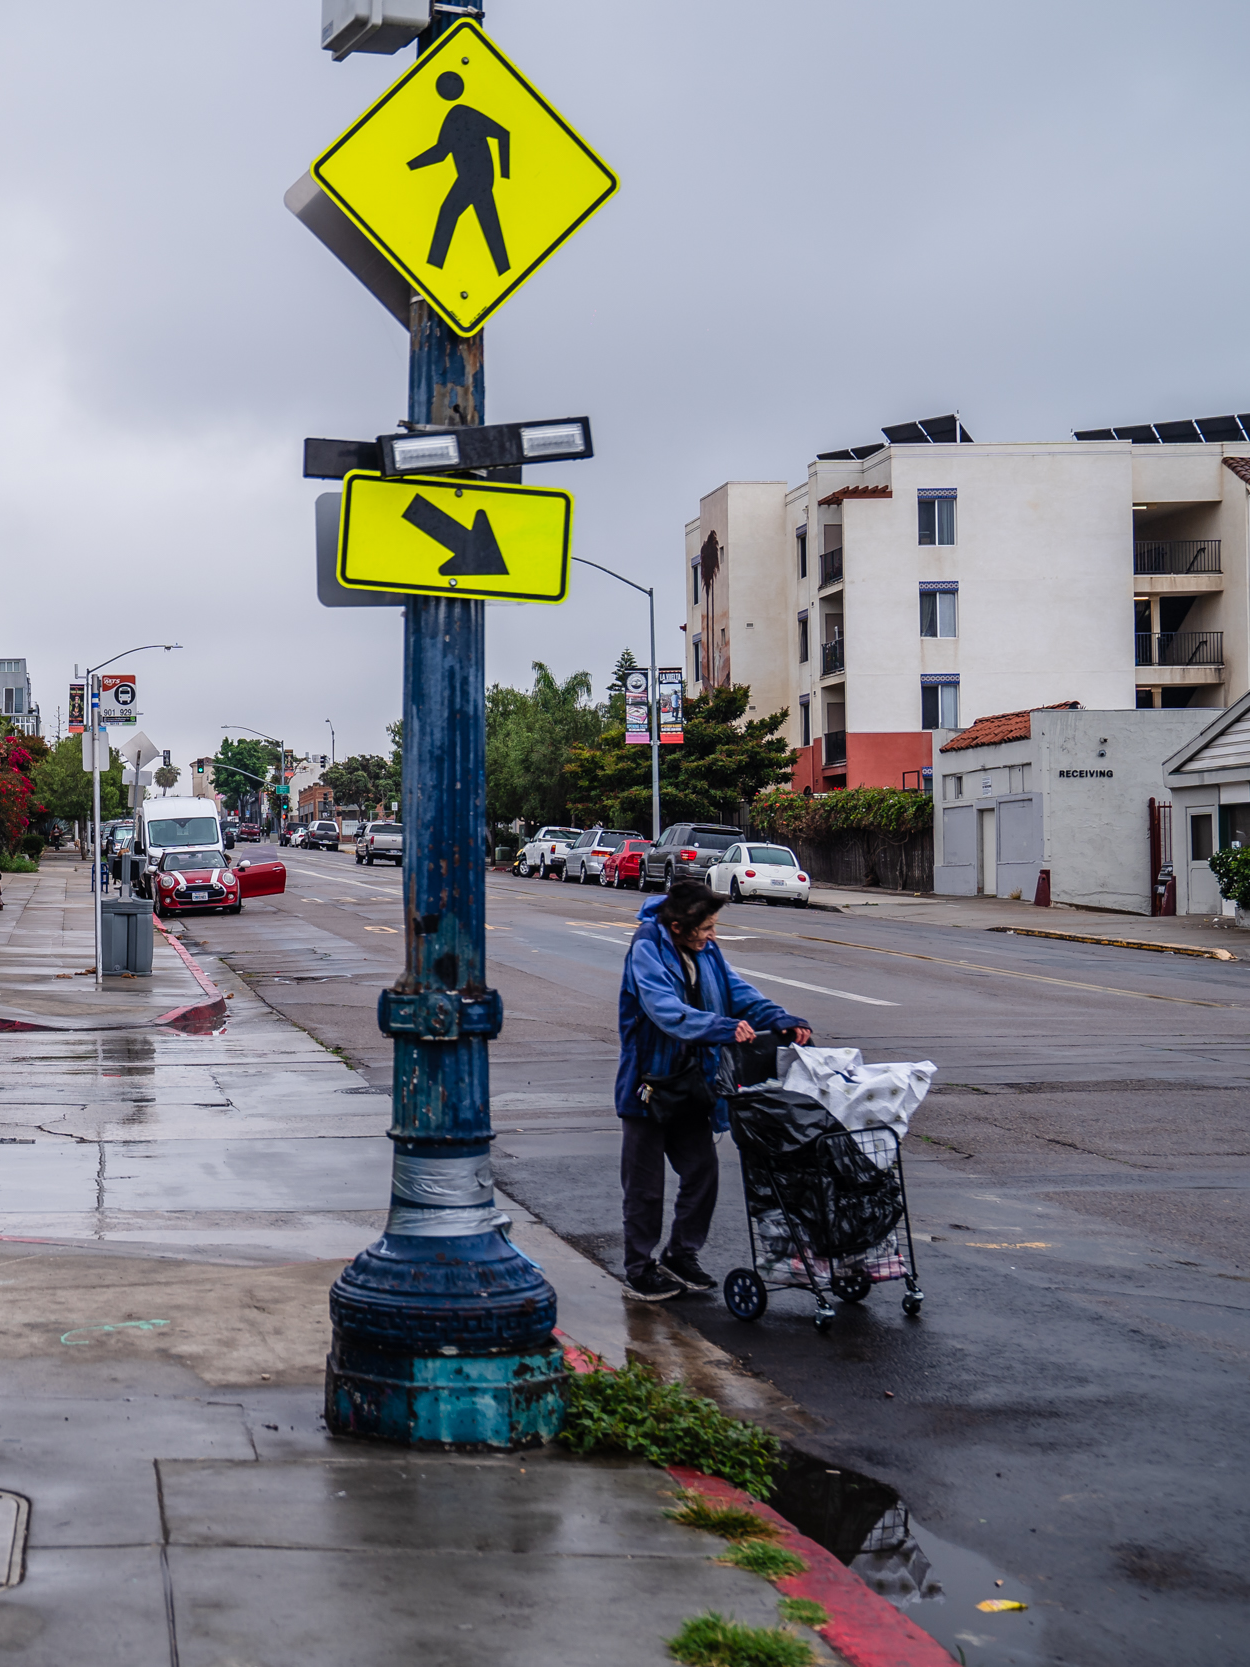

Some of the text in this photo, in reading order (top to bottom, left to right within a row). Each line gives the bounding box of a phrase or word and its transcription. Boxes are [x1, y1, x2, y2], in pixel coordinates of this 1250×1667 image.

[103, 708, 132, 716] 901 929
[1059, 769, 1114, 778] RECEIVING
